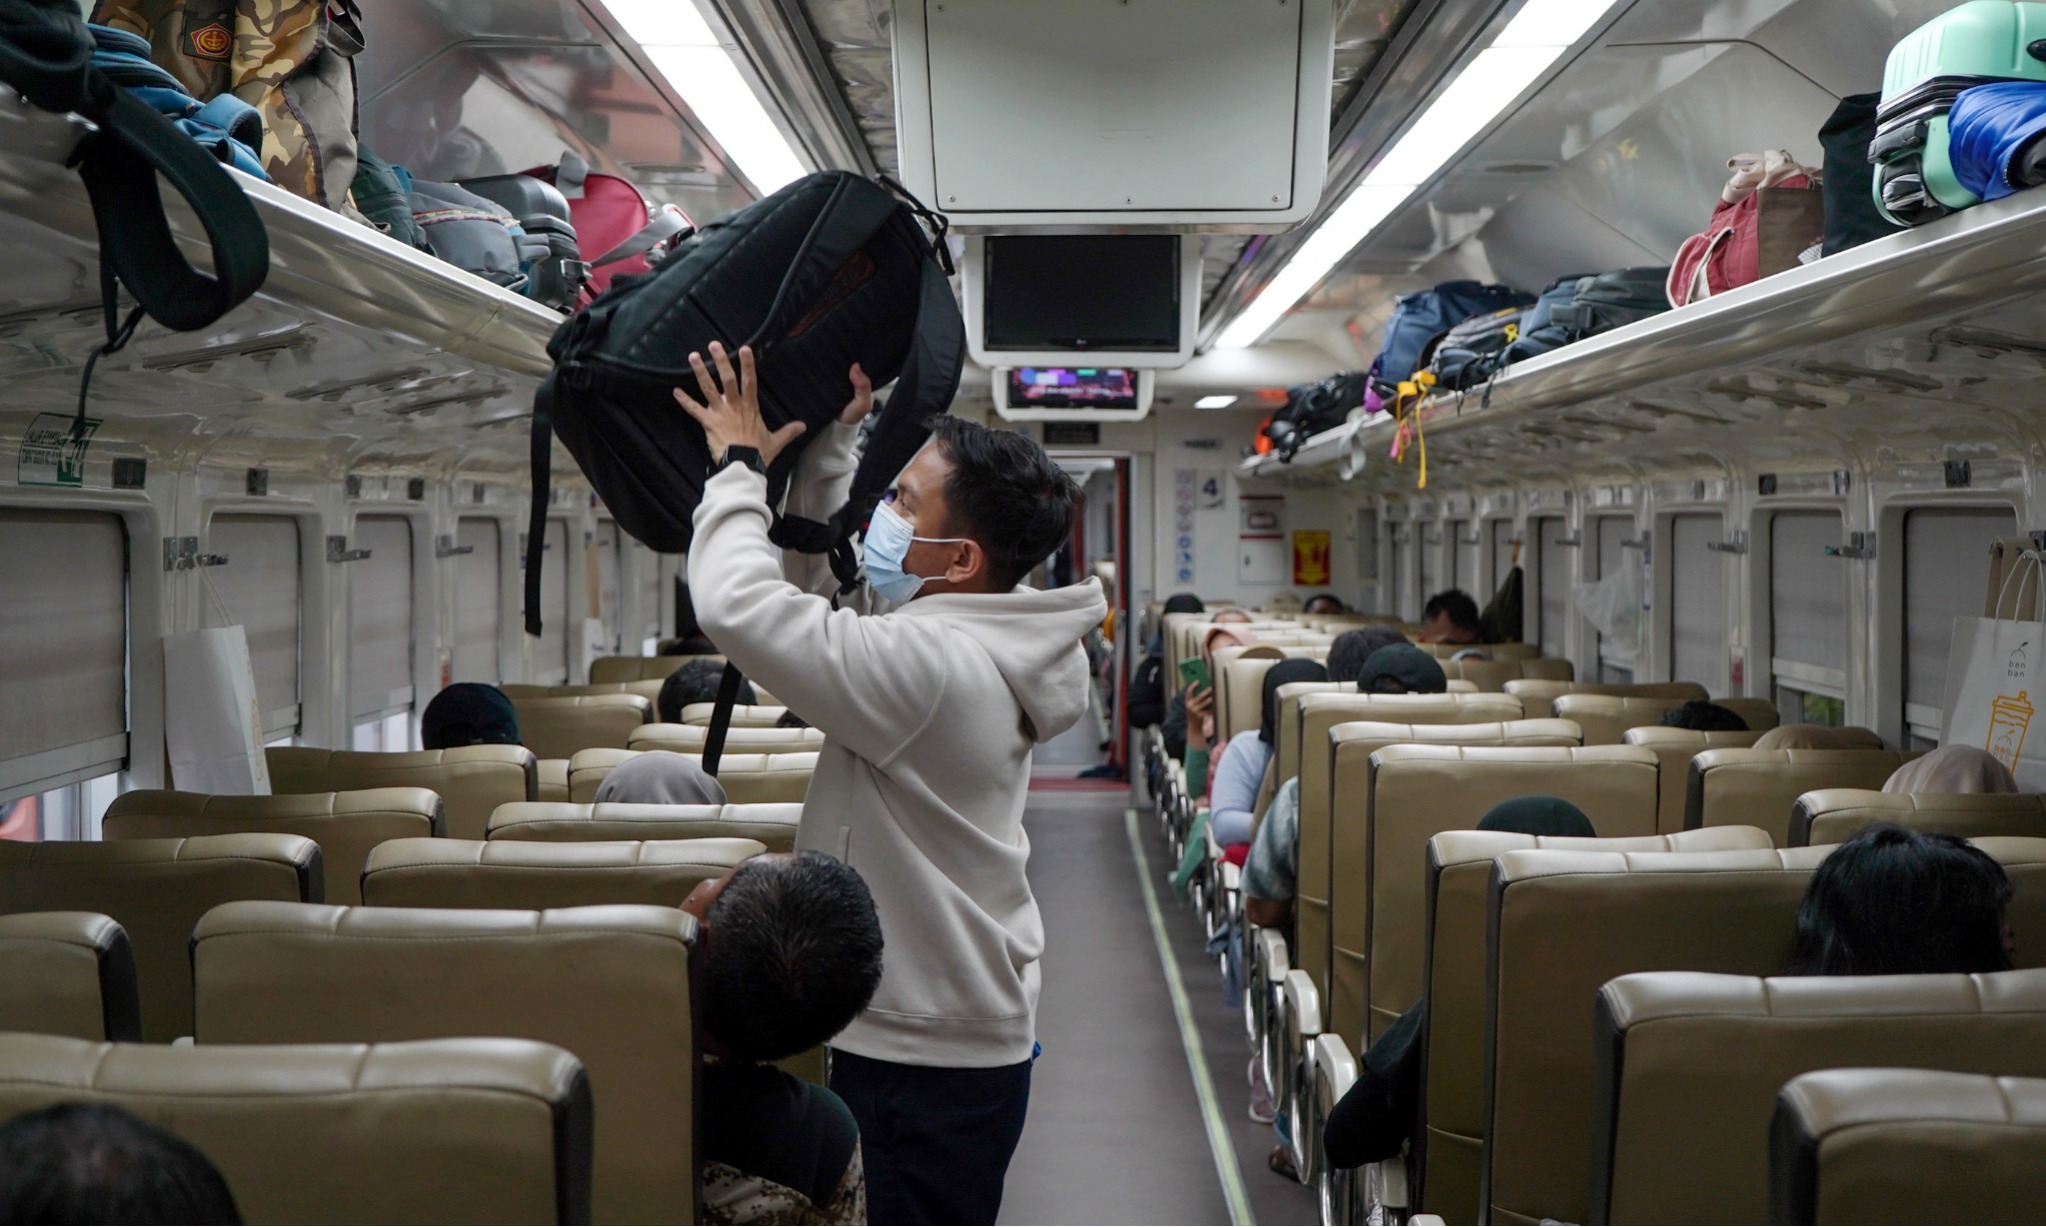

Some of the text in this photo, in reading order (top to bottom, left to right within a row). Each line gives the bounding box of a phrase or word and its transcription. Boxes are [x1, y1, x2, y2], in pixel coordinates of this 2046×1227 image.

[1203, 478, 1218, 496] 4
[2008, 660, 2026, 669] ban
[2008, 669, 2024, 678] ban
